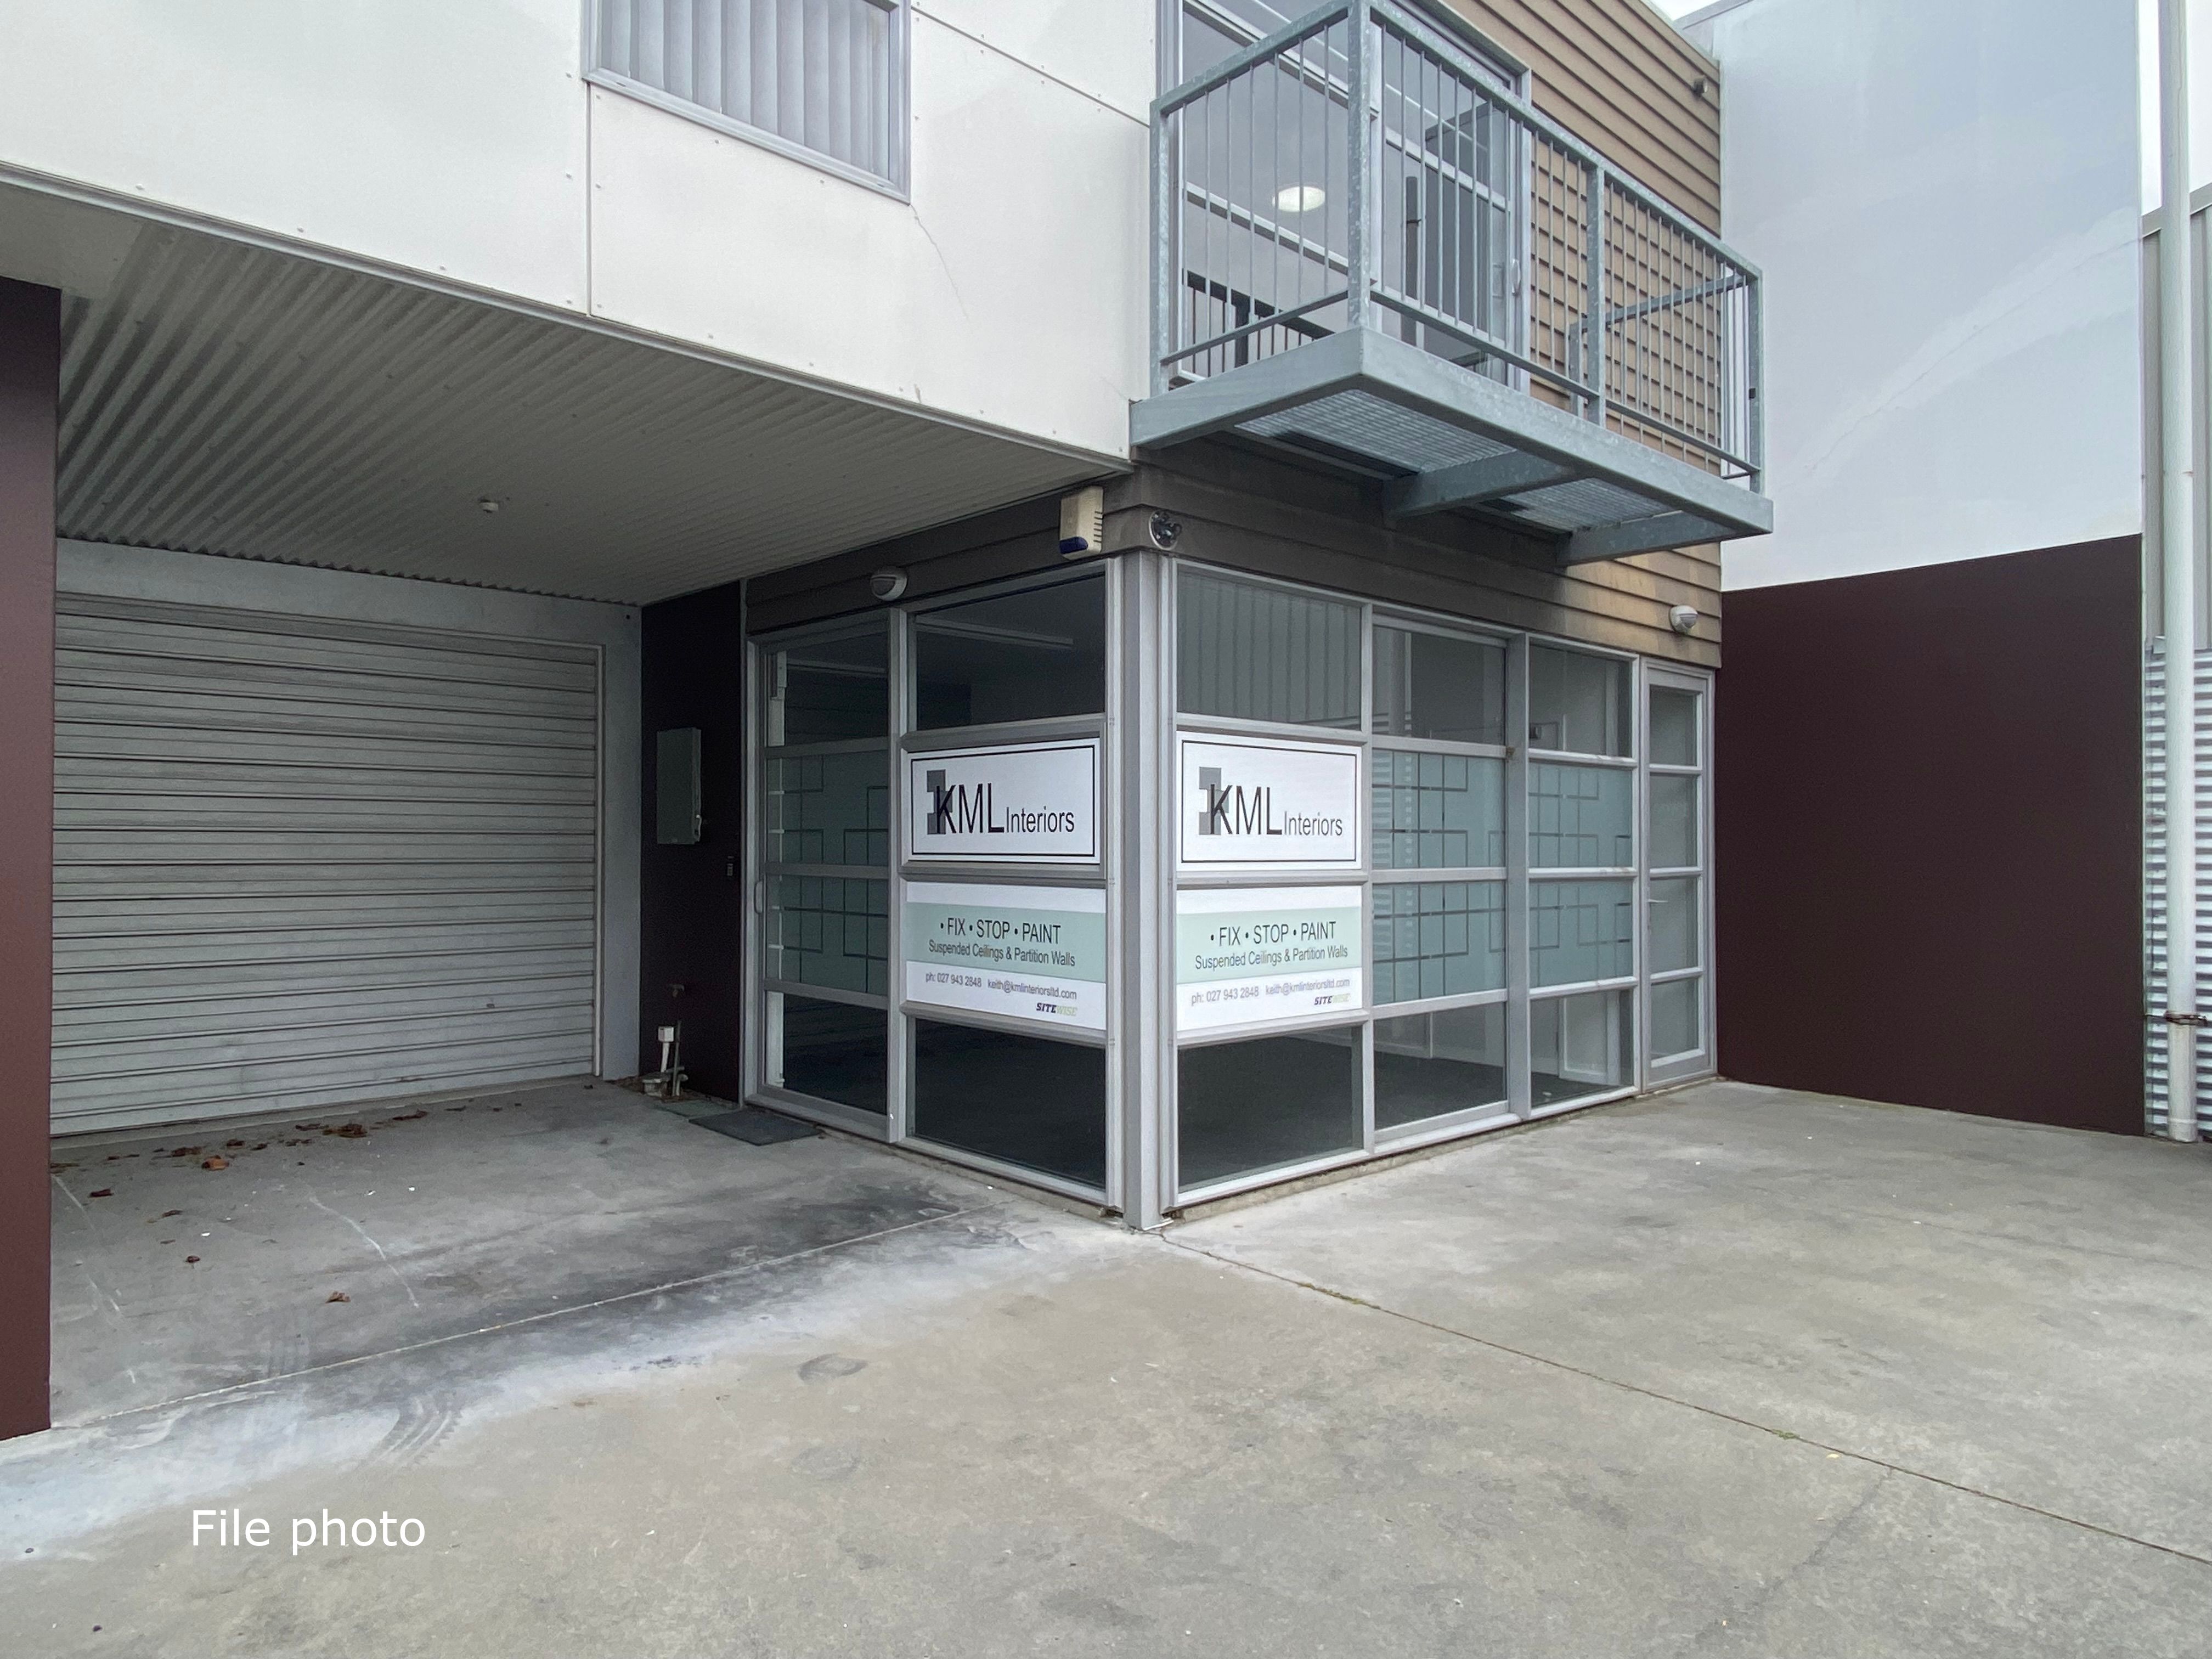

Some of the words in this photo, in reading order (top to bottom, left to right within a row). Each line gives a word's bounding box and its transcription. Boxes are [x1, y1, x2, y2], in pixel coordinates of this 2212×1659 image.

[936, 783, 1005, 833] KML
[1006, 805, 1075, 833] Interiors
[1210, 784, 1282, 834] KML
[1284, 811, 1343, 836] Interiors
[947, 917, 966, 936] FIX
[977, 919, 1011, 940] STOP
[1023, 923, 1061, 944] PAINT
[1219, 927, 1241, 946] FIX
[1253, 924, 1289, 944] STOP
[1301, 921, 1336, 941] PAINT
[929, 939, 970, 956] Suspended
[973, 944, 1004, 962] Ceilings
[1006, 948, 1012, 961] &
[1014, 947, 1049, 964] Partition
[1052, 951, 1076, 967] Walls
[1195, 953, 1246, 971] Suspended
[1248, 950, 1282, 967] Ceilings
[1284, 949, 1290, 962] &
[1293, 947, 1325, 961] Partition
[1327, 945, 1348, 958] Walls
[937, 973, 949, 983] 027
[950, 975, 963, 985] 943
[1191, 992, 1204, 1006] ph:
[1206, 989, 1221, 1002] 027
[1223, 988, 1238, 1000] 943
[1240, 986, 1259, 998] 2848
